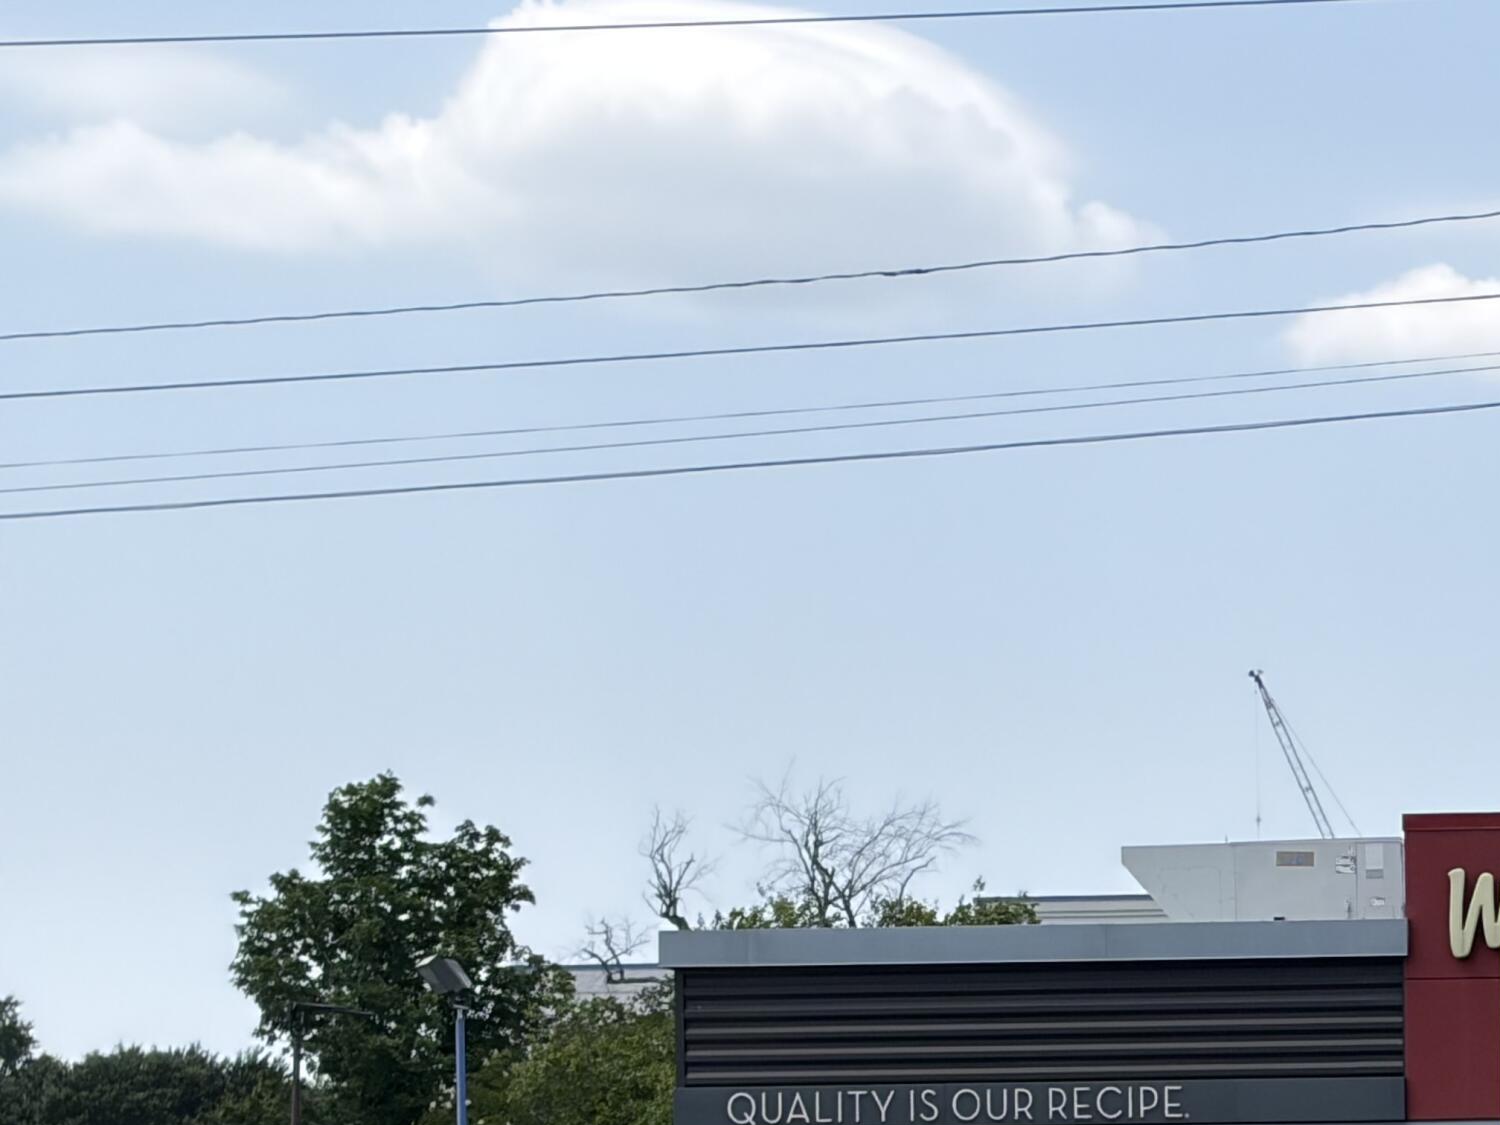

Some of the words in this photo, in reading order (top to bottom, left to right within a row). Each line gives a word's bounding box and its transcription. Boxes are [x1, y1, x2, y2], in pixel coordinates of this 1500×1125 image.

[909, 1089, 939, 1122] IS
[952, 1088, 1034, 1121] OUR
[1048, 1086, 1190, 1120] RECIPE.
